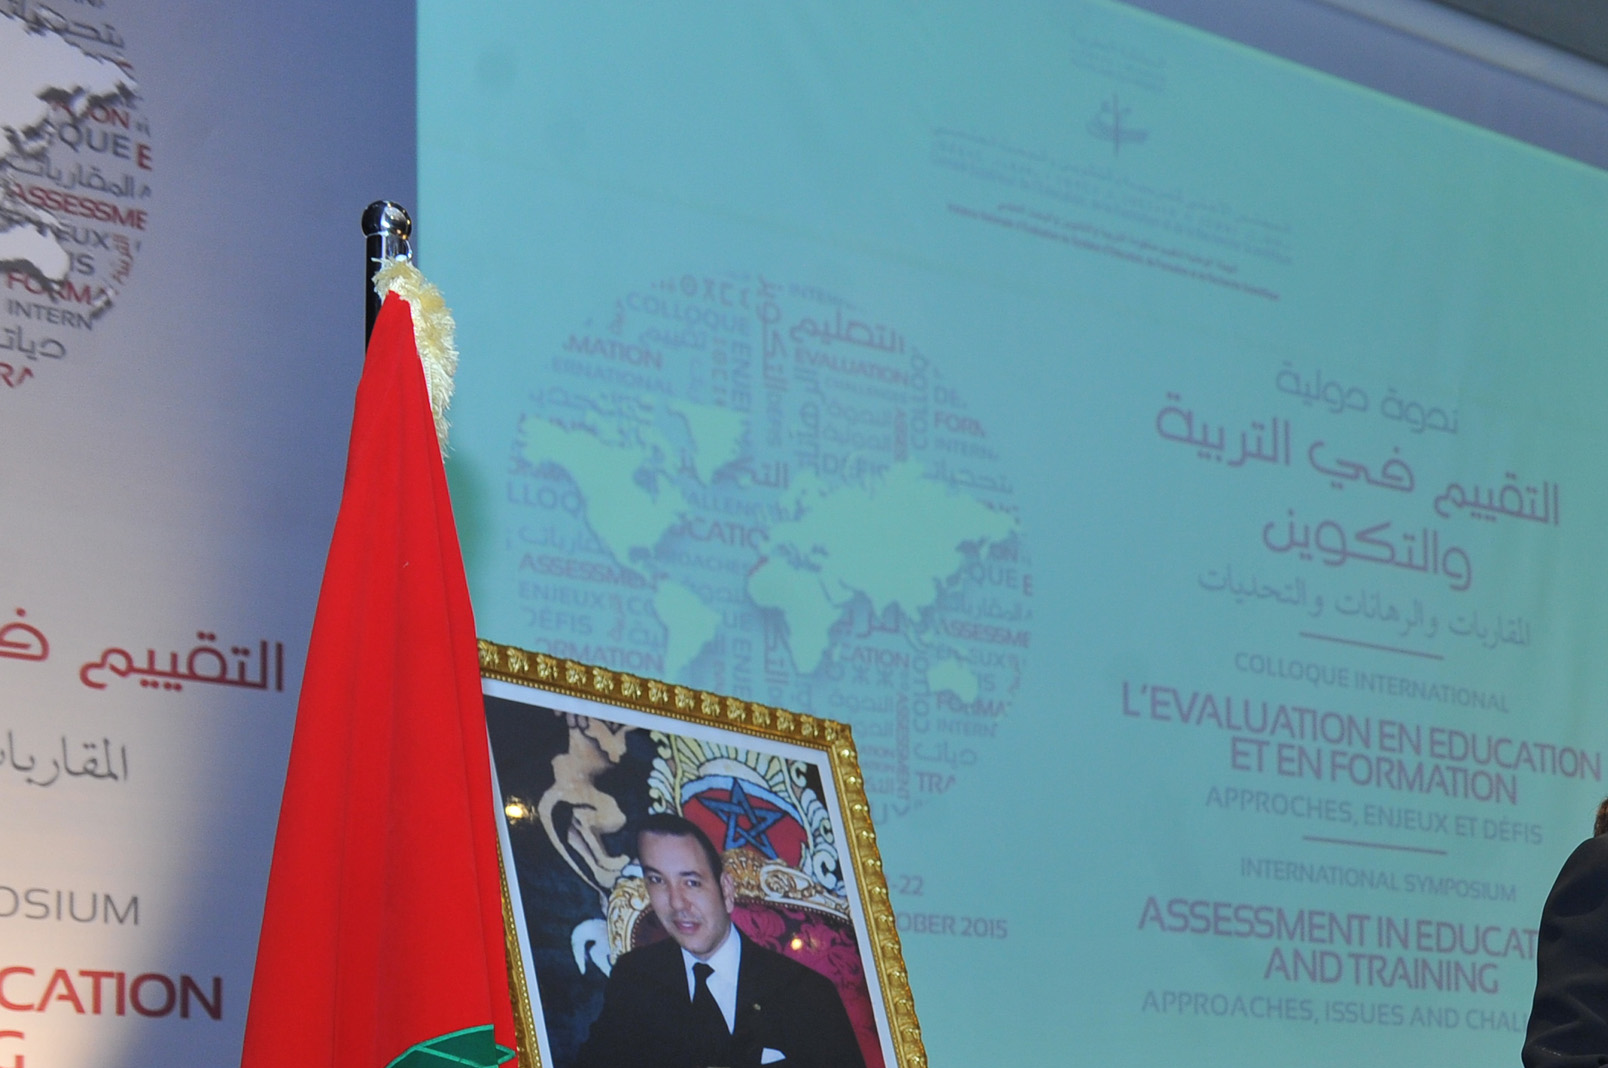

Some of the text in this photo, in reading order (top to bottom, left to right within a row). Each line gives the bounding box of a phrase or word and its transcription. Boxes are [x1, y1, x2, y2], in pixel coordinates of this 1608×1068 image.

[1275, 360, 1458, 434] ندوة دولية
[1155, 391, 1560, 526] التقييم في التربية
[1262, 508, 1473, 592] والتكوين
[79, 630, 285, 692] التقييم
[1234, 651, 1509, 714] COLLOQUE INTERNATIONAL
[1230, 736, 1520, 805] ET EN FORMATION
[1378, 719, 1422, 757] EN
[1429, 725, 1603, 782] EDUCATION
[1204, 786, 1360, 829] APPROCHES,
[1363, 804, 1450, 836] ENJEUX
[1454, 817, 1478, 839] ET
[1240, 856, 1518, 903] INTERNATIONAL SYMPOSIUM
[960, 916, 1009, 941] 2015
[1137, 895, 1372, 948] ASSESSMENT
[1377, 915, 1421, 950] IN
[1263, 946, 1499, 995] AND TRAINING
[1141, 990, 1320, 1025] APPROACHES,
[1325, 1002, 1405, 1028] ISSUES
[1409, 1004, 1460, 1030] AND
